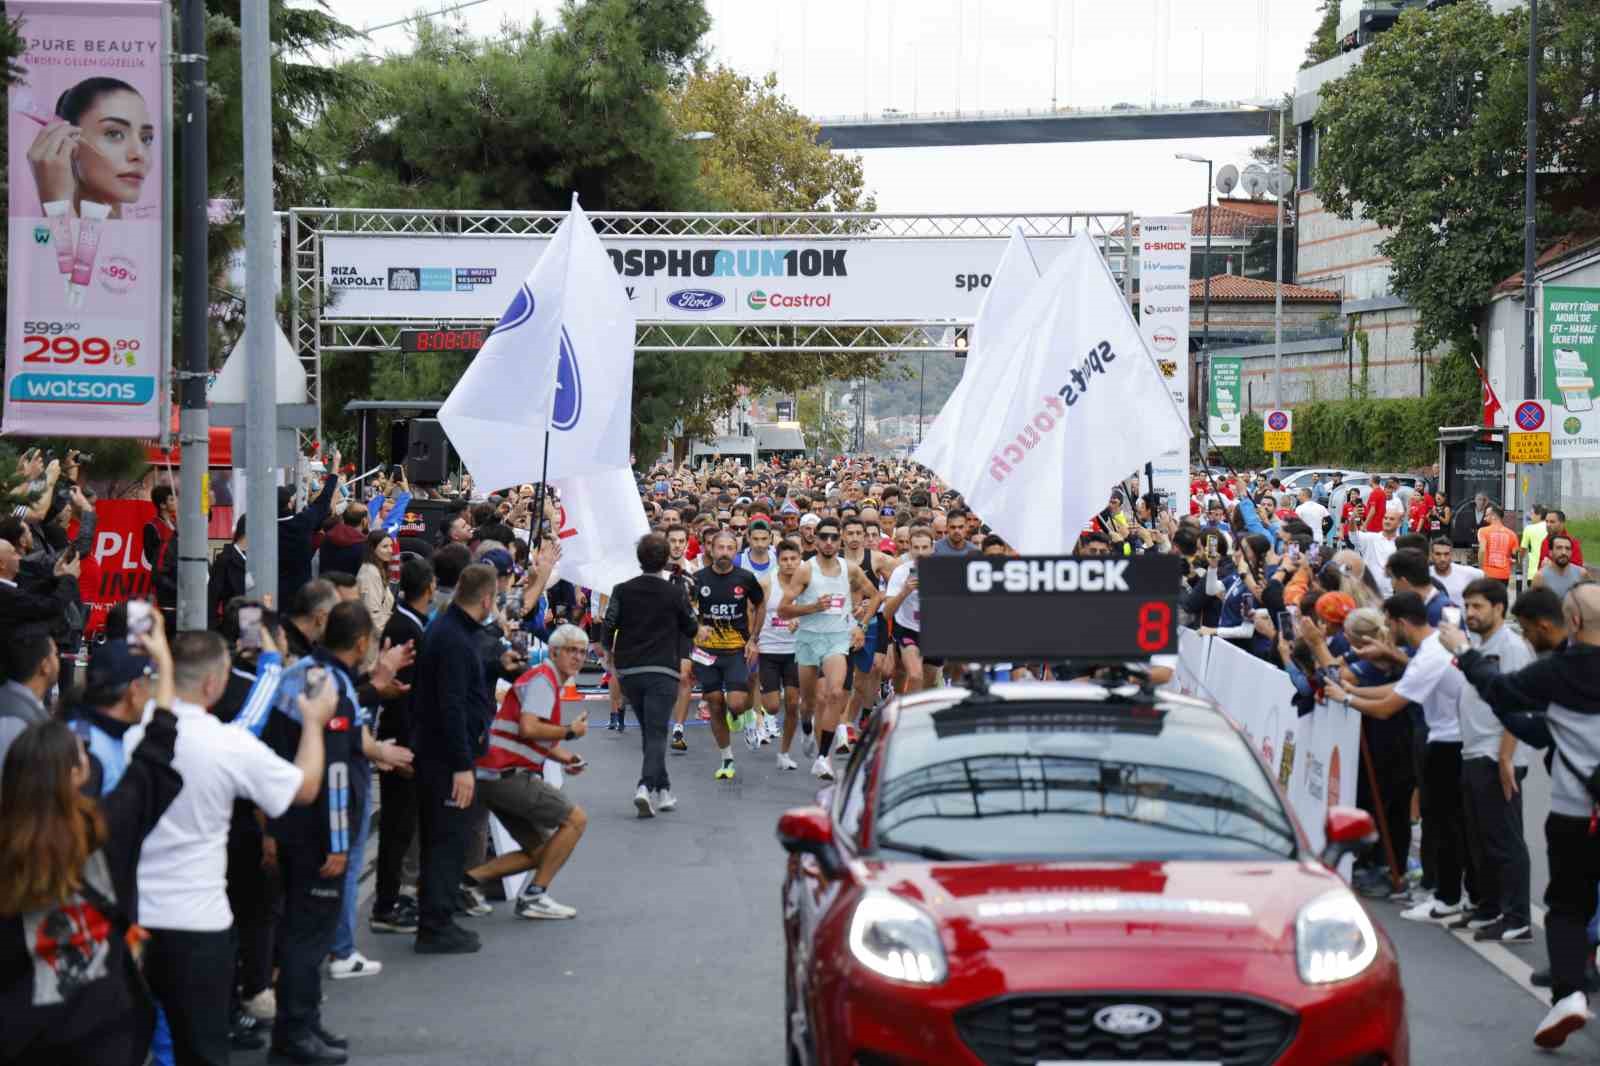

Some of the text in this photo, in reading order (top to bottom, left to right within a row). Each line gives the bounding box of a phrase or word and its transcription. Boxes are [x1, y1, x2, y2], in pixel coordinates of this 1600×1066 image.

[31, 39, 157, 53] PURE BEAUTY
[1144, 242, 1186, 250] G-SHOCK
[331, 266, 358, 276] RIZA
[331, 276, 385, 287] AKPOLAT
[677, 292, 714, 309] Ford
[769, 293, 832, 309] Castrol
[27, 380, 136, 399] watsons
[966, 560, 1131, 592] G-SHOCK
[1137, 601, 1172, 651] 8
